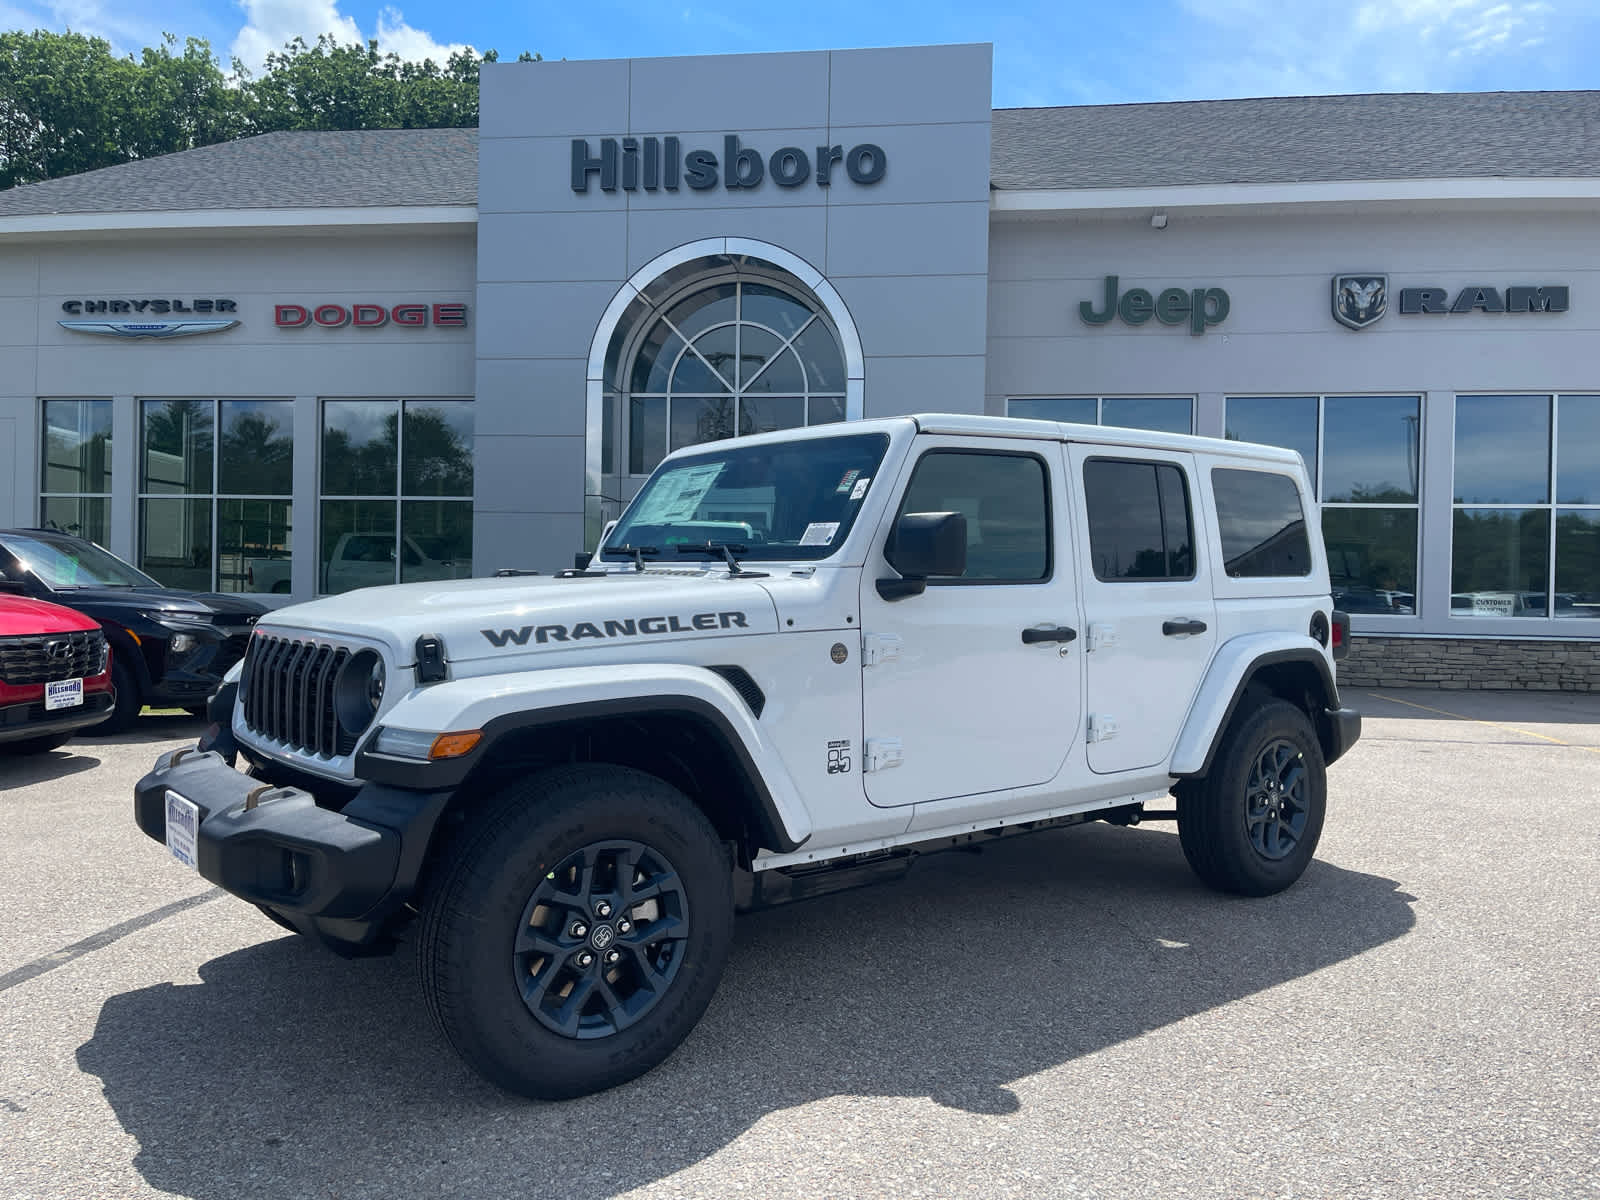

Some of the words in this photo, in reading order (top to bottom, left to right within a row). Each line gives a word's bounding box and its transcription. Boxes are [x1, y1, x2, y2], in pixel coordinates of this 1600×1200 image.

[571, 134, 887, 193] Hillsboro
[62, 299, 238, 314] CHRYSLER
[1080, 275, 1231, 335] Jeep
[1400, 286, 1570, 313] RAM
[274, 304, 467, 328] DODGE
[480, 611, 750, 648] WRANGLER
